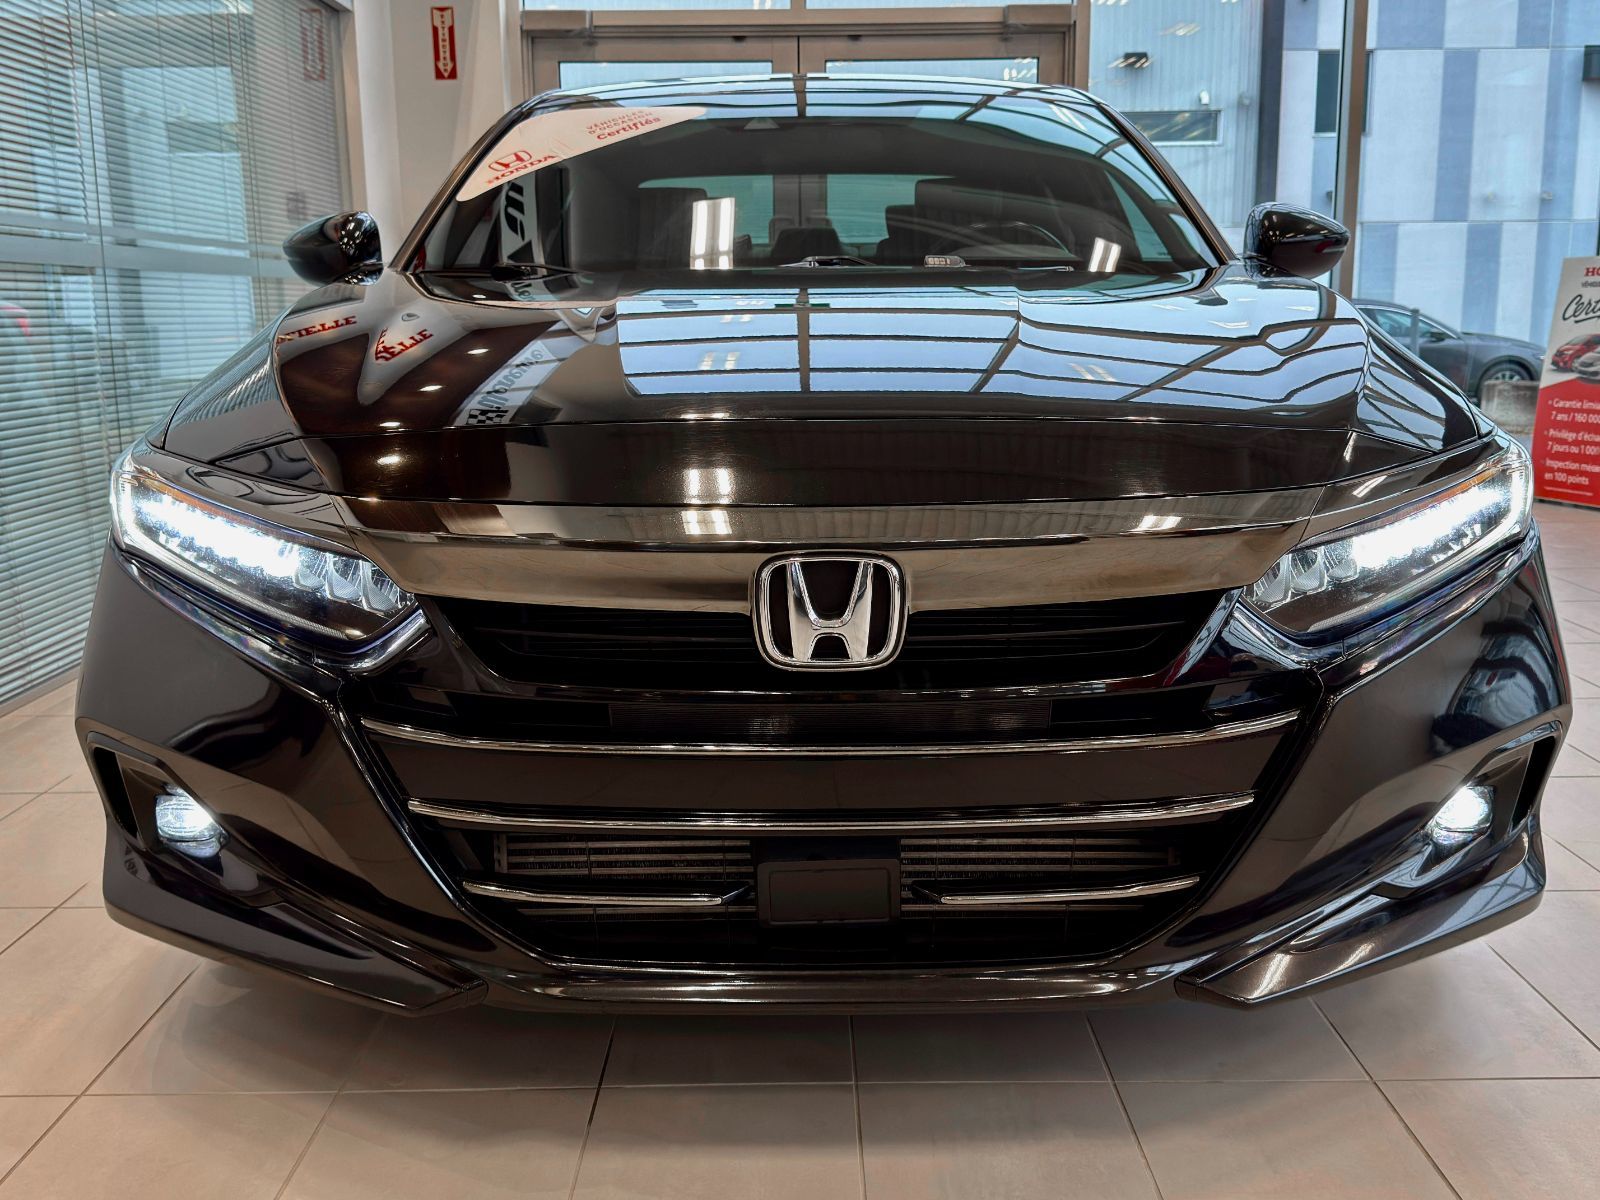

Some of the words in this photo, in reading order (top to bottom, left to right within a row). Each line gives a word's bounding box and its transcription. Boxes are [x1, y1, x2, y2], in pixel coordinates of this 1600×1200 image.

[596, 117, 662, 140] Certifiés
[486, 154, 558, 185] HONDA
[1553, 398, 1582, 409] Garantie
[1556, 413, 1569, 421] ans
[1552, 441, 1569, 454] jours
[1569, 445, 1579, 454] ou
[1545, 457, 1580, 470] Inspection
[1544, 472, 1553, 481] en
[1554, 471, 1567, 482] 100
[1567, 474, 1589, 486] points
